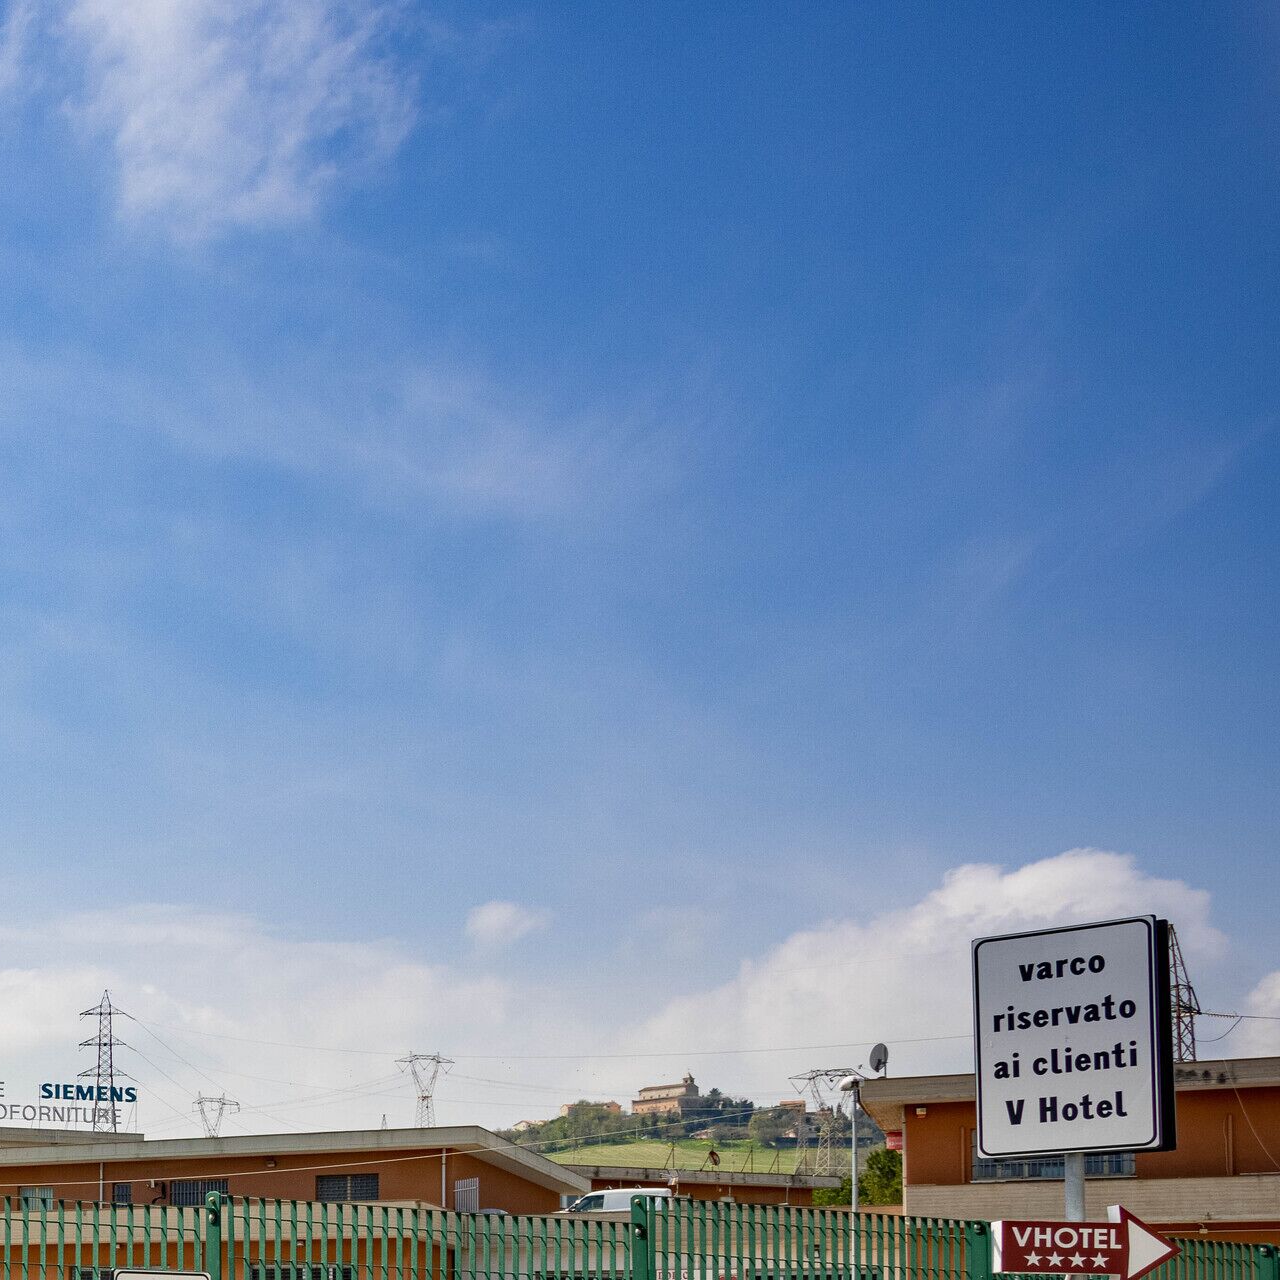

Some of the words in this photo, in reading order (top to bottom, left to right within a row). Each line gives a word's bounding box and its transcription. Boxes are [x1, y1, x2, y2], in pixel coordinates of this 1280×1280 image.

[1018, 954, 1106, 982] varco
[993, 994, 1137, 1032] riservato
[993, 1053, 1020, 1079] ai
[1032, 1040, 1138, 1075] clienti
[41, 1083, 137, 1103] SIEMENS
[1005, 1099, 1025, 1125] V
[1039, 1091, 1128, 1123] Hotel
